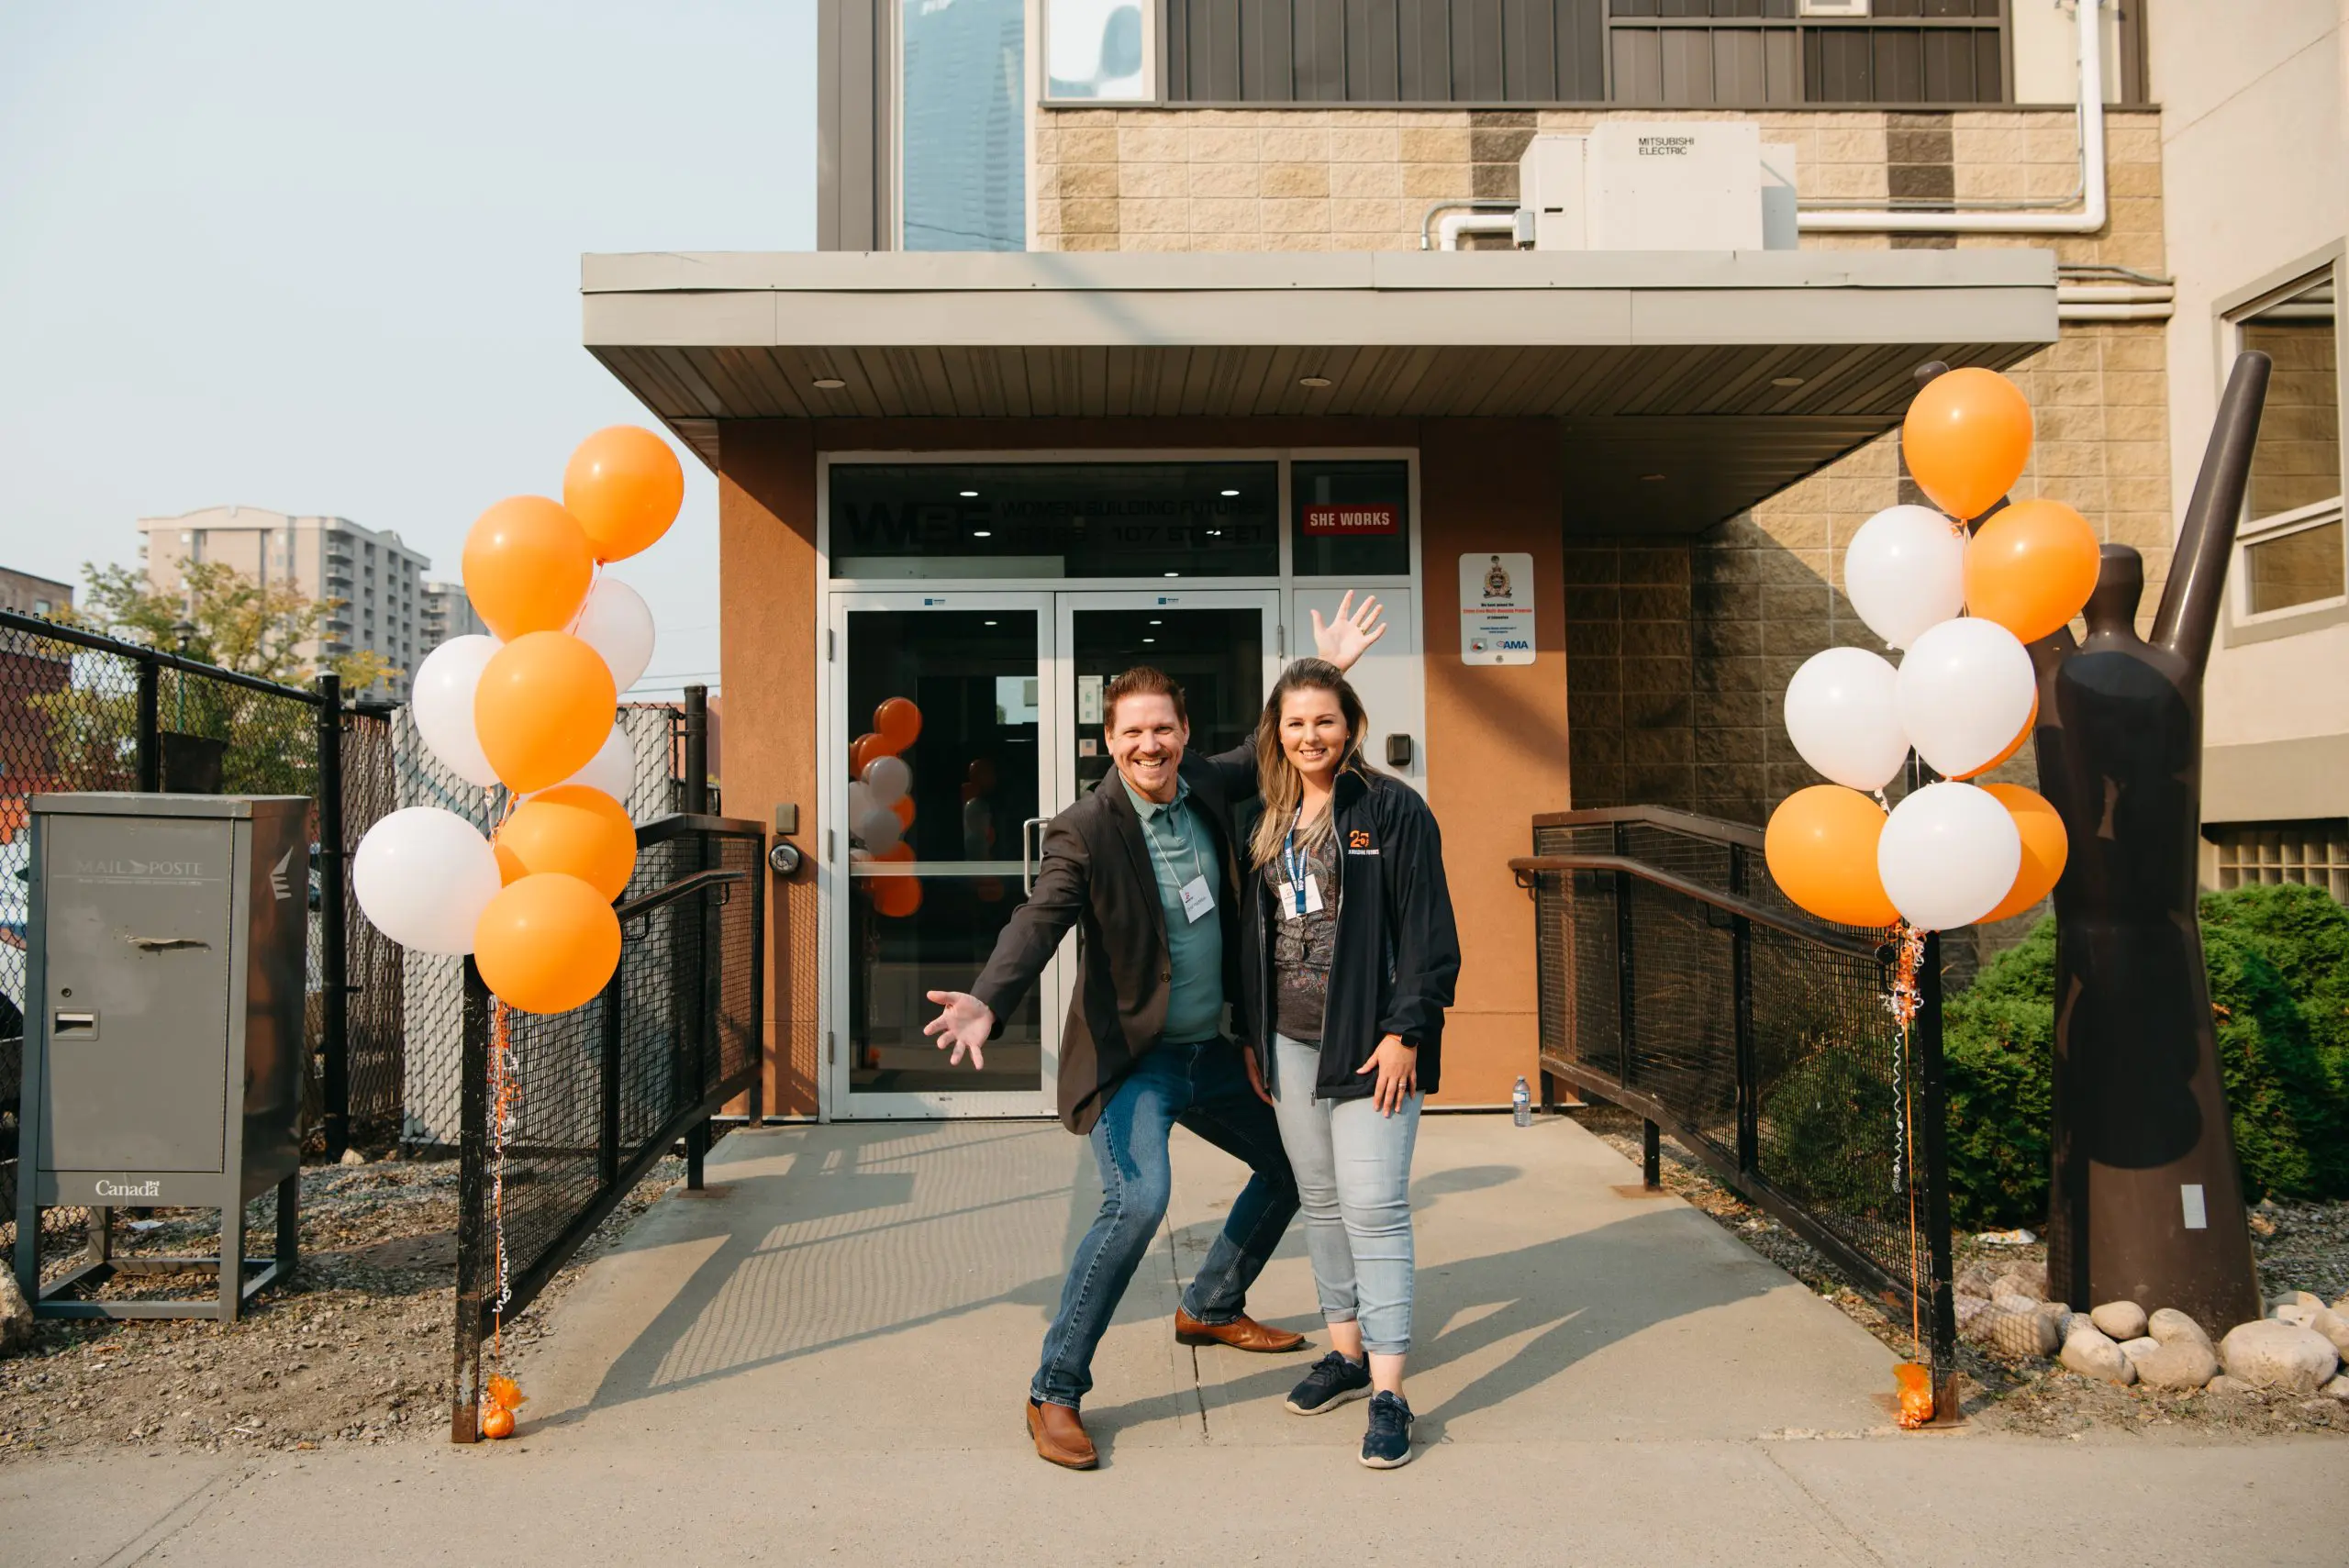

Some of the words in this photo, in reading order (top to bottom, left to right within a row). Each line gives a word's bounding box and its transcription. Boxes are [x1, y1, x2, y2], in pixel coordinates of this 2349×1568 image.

[1638, 137, 1695, 146] MITSUBISHI
[1638, 147, 1687, 156] ELECTRIC
[1001, 499, 1080, 517] WOMEN
[1085, 499, 1174, 517] BUILDING
[1309, 513, 1335, 527] SHE
[1340, 512, 1390, 526] WORKS
[1112, 525, 1159, 543] 107
[1503, 640, 1529, 650] AMA
[76, 859, 127, 874] MAIL
[149, 860, 203, 876] POSTE
[95, 1179, 161, 1196] Canada
